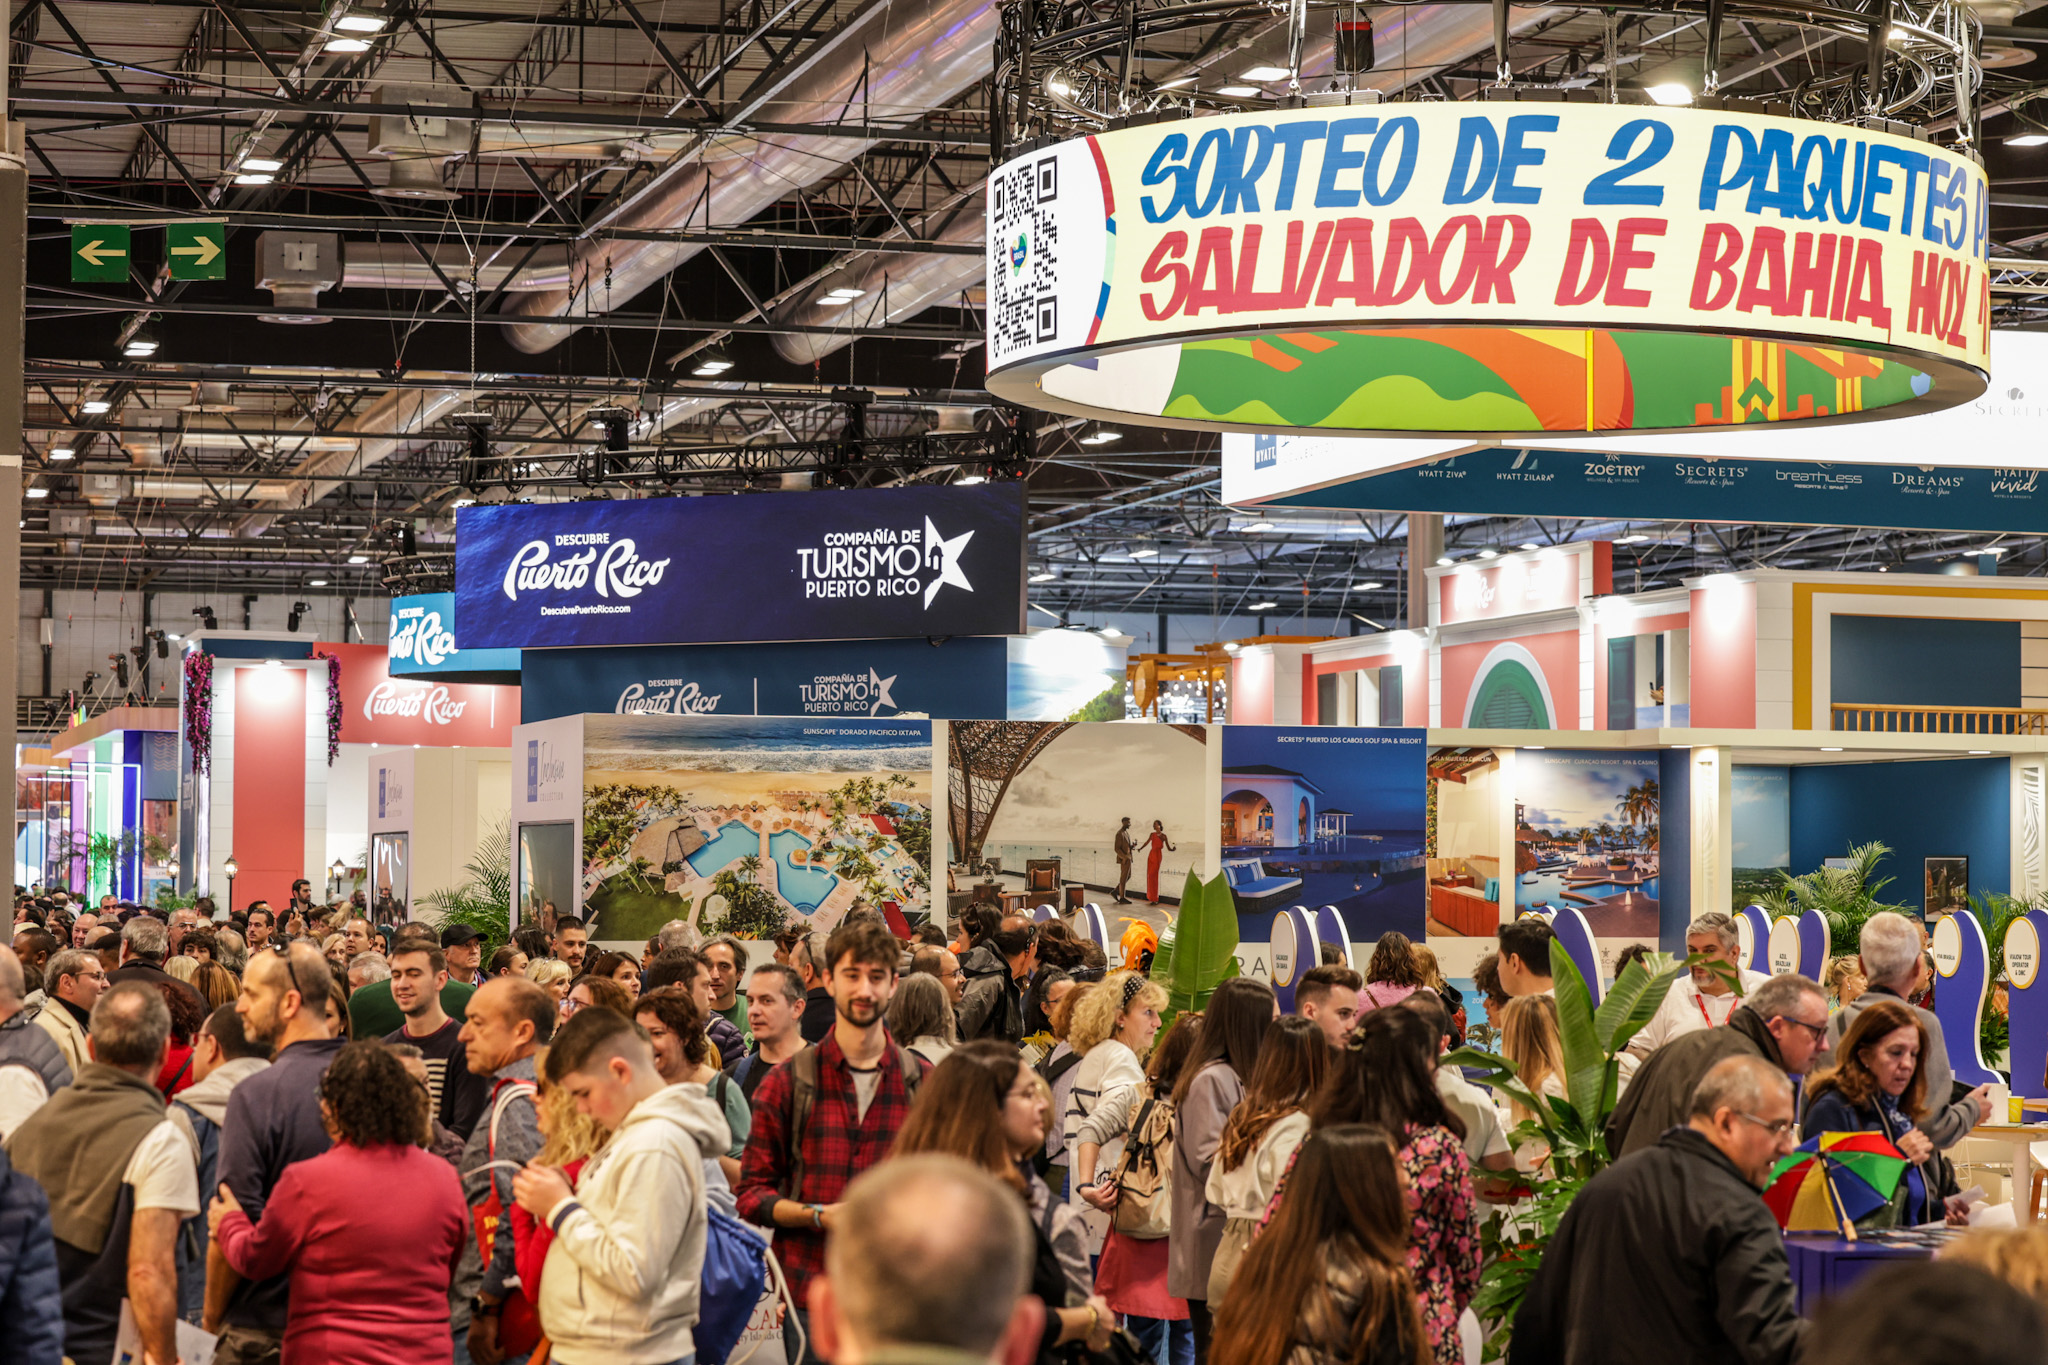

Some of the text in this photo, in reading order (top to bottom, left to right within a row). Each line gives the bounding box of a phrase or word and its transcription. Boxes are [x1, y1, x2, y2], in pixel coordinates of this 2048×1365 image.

[1140, 116, 1420, 223] SORTEO
[1442, 115, 1560, 205] DE
[1583, 119, 1674, 207] 2
[1699, 124, 1967, 250] PAQUETES
[1013, 246, 1025, 261] BRASIL
[1140, 214, 1531, 321] SALVADOR
[1554, 217, 1668, 307] DE
[1907, 250, 1971, 349] HOY
[1419, 470, 1443, 478] HYATT
[1497, 472, 1522, 481] HYATT
[1991, 470, 2039, 493] vivid
[555, 533, 610, 546] DESCUBRE
[824, 529, 921, 546] COMPAÑÍA DE
[503, 538, 671, 601] Puerto Rico
[797, 544, 921, 579] TURISMO
[806, 577, 920, 598] PUERTO RICO
[541, 605, 631, 616] DescubrePuertoRico.com
[648, 679, 683, 688] DESCUBRE
[814, 673, 867, 684] COMPAÑÍA DE
[615, 682, 721, 714] Puerto Rico
[799, 682, 868, 702] TURISMO
[363, 681, 467, 725] Puerto Rico
[804, 700, 868, 713] PUERTO RICO
[899, 729, 922, 737] IXTAPA
